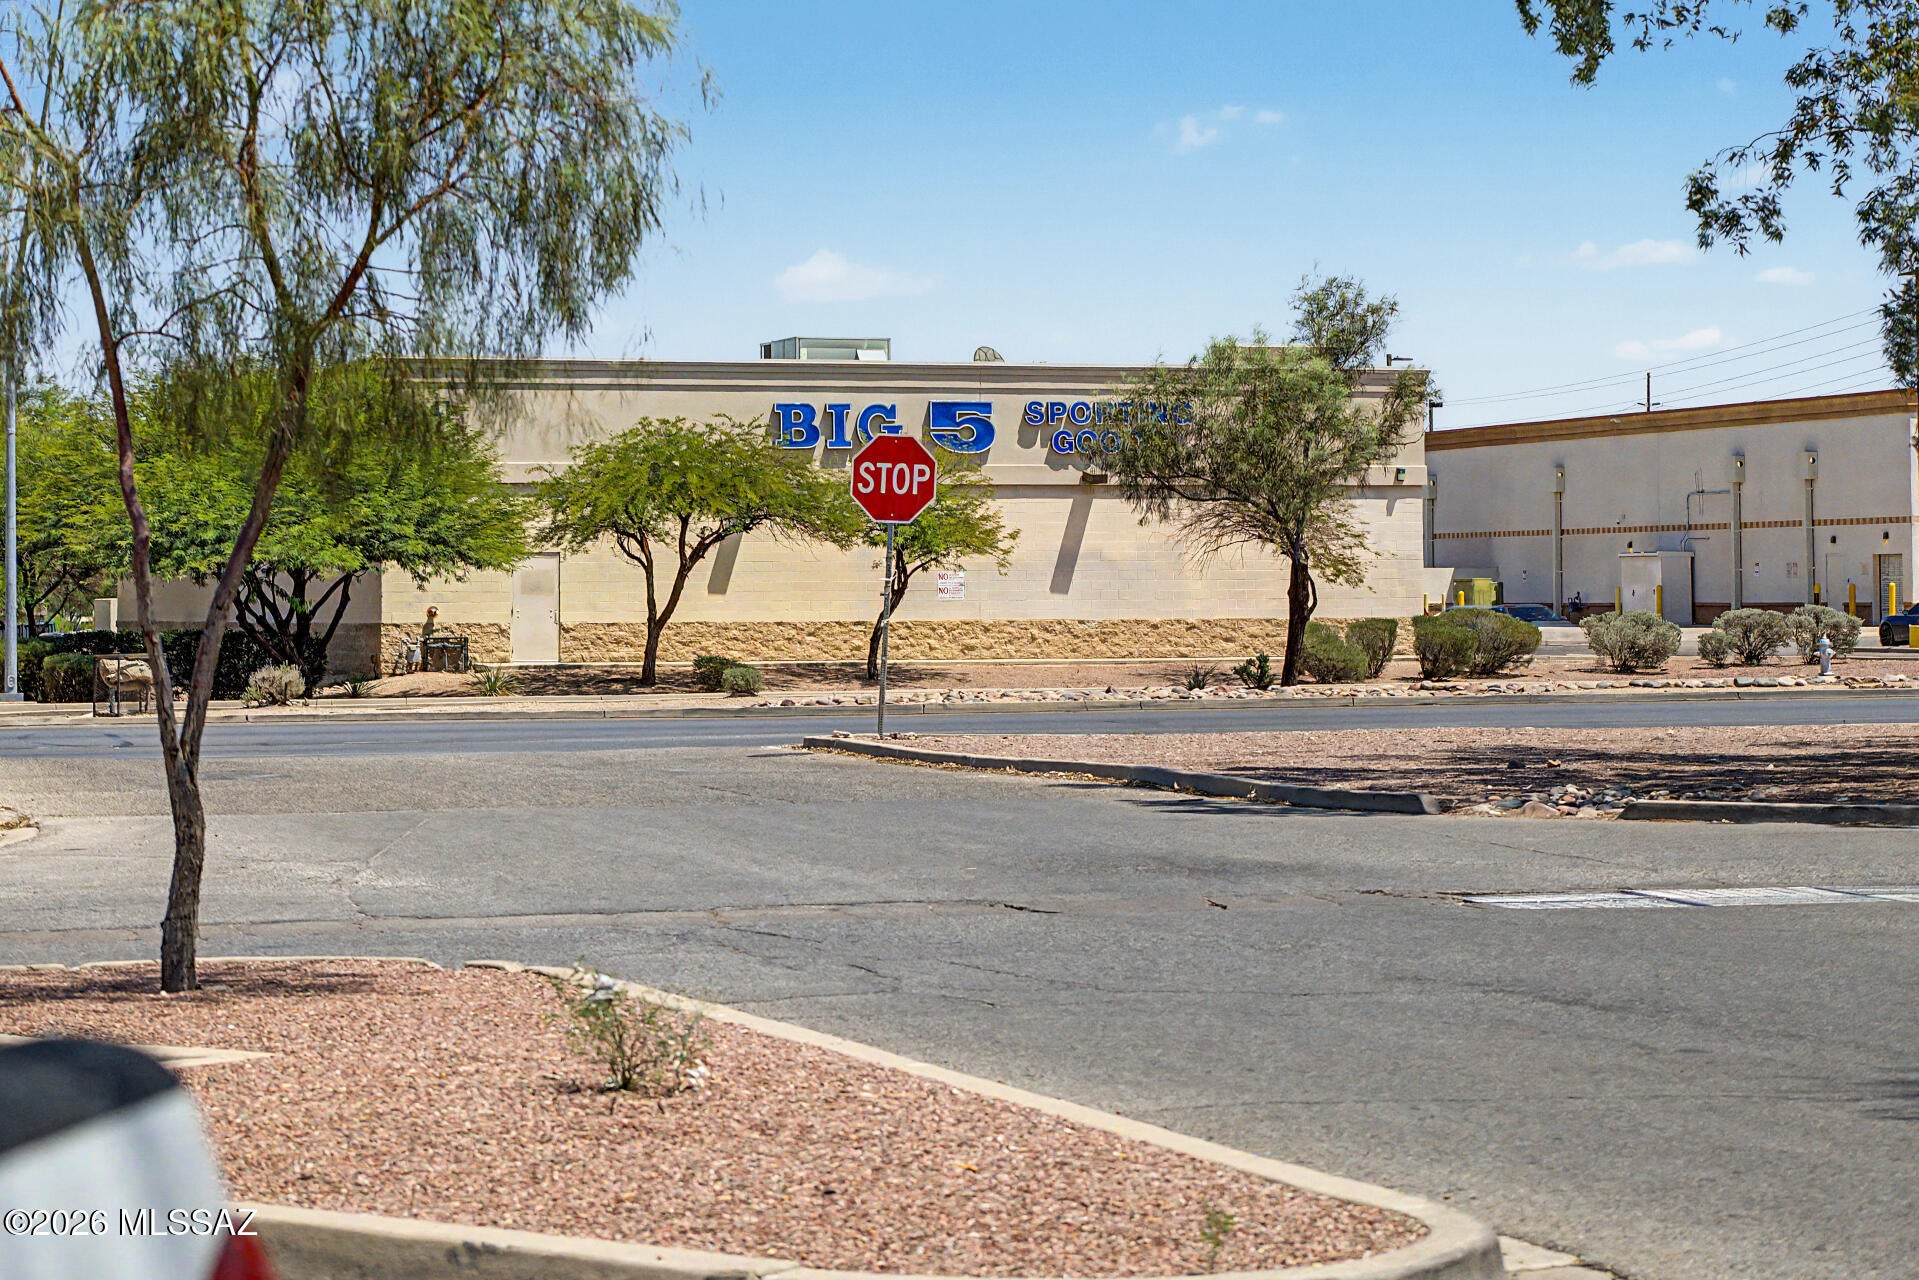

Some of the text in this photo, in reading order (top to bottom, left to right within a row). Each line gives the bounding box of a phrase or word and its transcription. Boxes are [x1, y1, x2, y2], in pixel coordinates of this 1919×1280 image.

[774, 400, 996, 453] BIG 5
[857, 461, 931, 495] STOP
[938, 572, 949, 581] NO
[938, 586, 949, 595] NO
